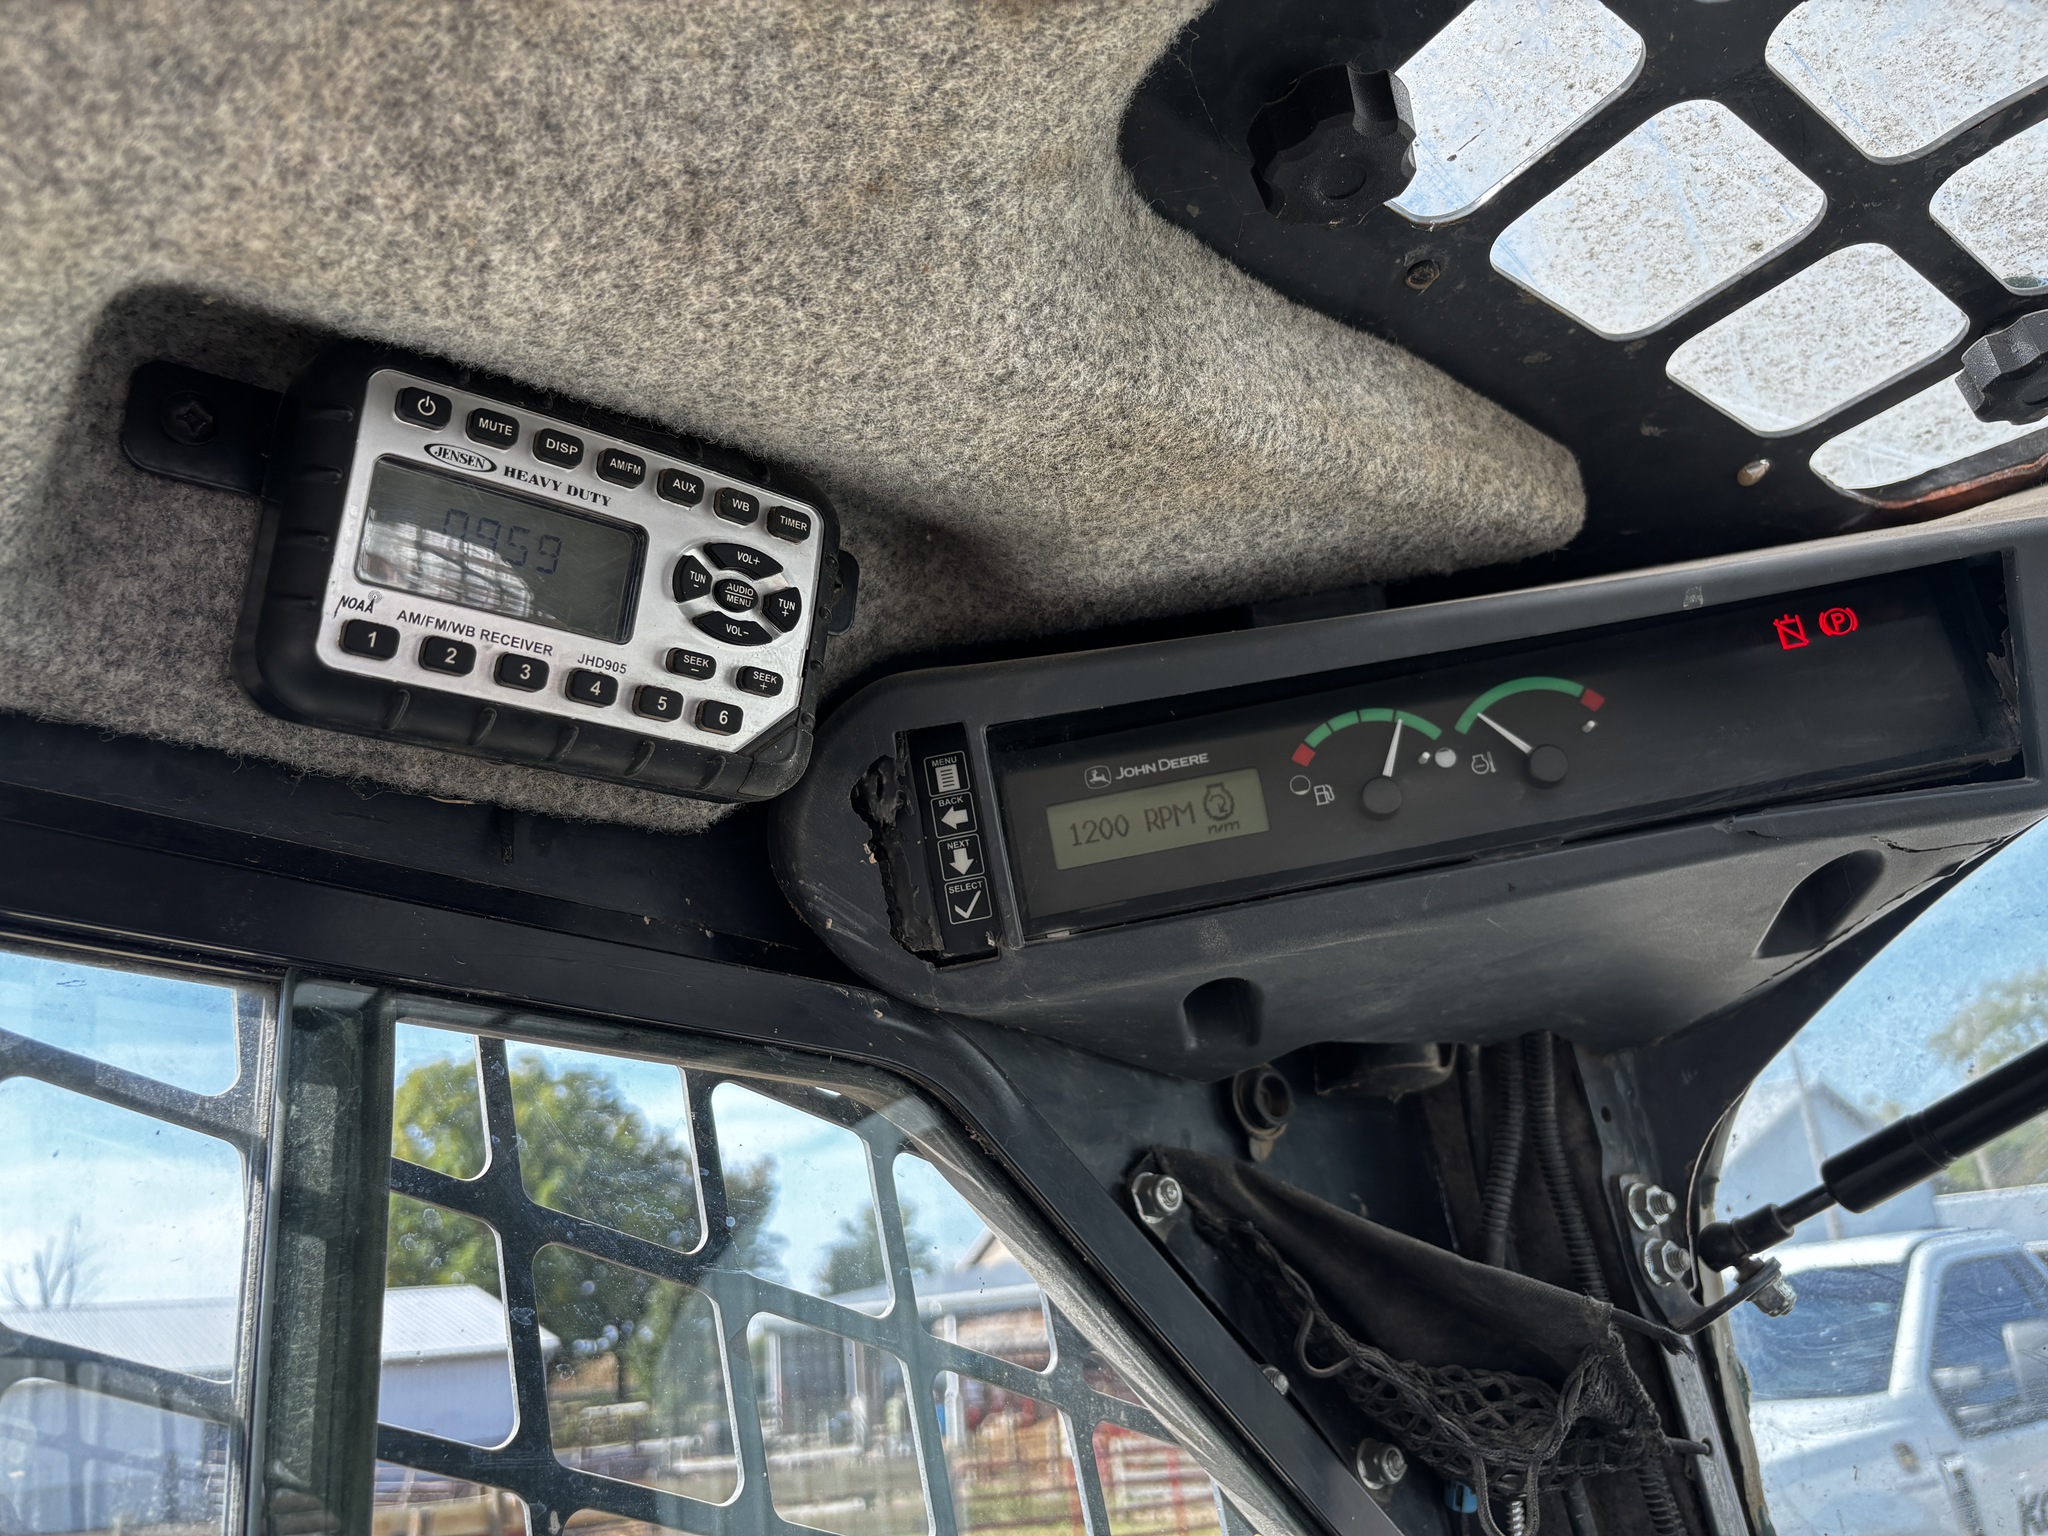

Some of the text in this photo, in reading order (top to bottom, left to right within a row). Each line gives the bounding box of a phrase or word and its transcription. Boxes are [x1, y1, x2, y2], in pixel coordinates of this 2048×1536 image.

[478, 417, 513, 436] MUTE
[546, 438, 579, 456] DISP
[609, 457, 642, 476] AM/FM
[434, 446, 612, 507] JENSEN HEAVY DUTY
[672, 478, 697, 495] AUX
[732, 498, 750, 512] WB
[780, 515, 808, 532] TIMER
[737, 551, 761, 566] VOL+
[690, 570, 707, 584] TUN
[726, 582, 754, 596] AUDIO
[333, 594, 376, 619] NOAA
[726, 594, 752, 608] MENU
[778, 598, 796, 611] TUN
[367, 631, 378, 648] 1
[396, 609, 554, 656] AM/FM/WB RECEIVER
[444, 647, 458, 664] 2
[577, 653, 628, 674] JHD905
[683, 654, 710, 668] SEEK
[519, 664, 531, 680] 3
[752, 671, 777, 684] SEEK
[589, 680, 601, 696] 4
[657, 696, 667, 711] 5
[719, 710, 729, 725] 6
[931, 755, 958, 768] MENU
[1115, 753, 1210, 780] JOHN DEERE
[938, 795, 964, 808] BACK
[1069, 801, 1197, 847] 1200 RPM
[946, 838, 970, 851] NEXT
[948, 880, 983, 894] SELECT
